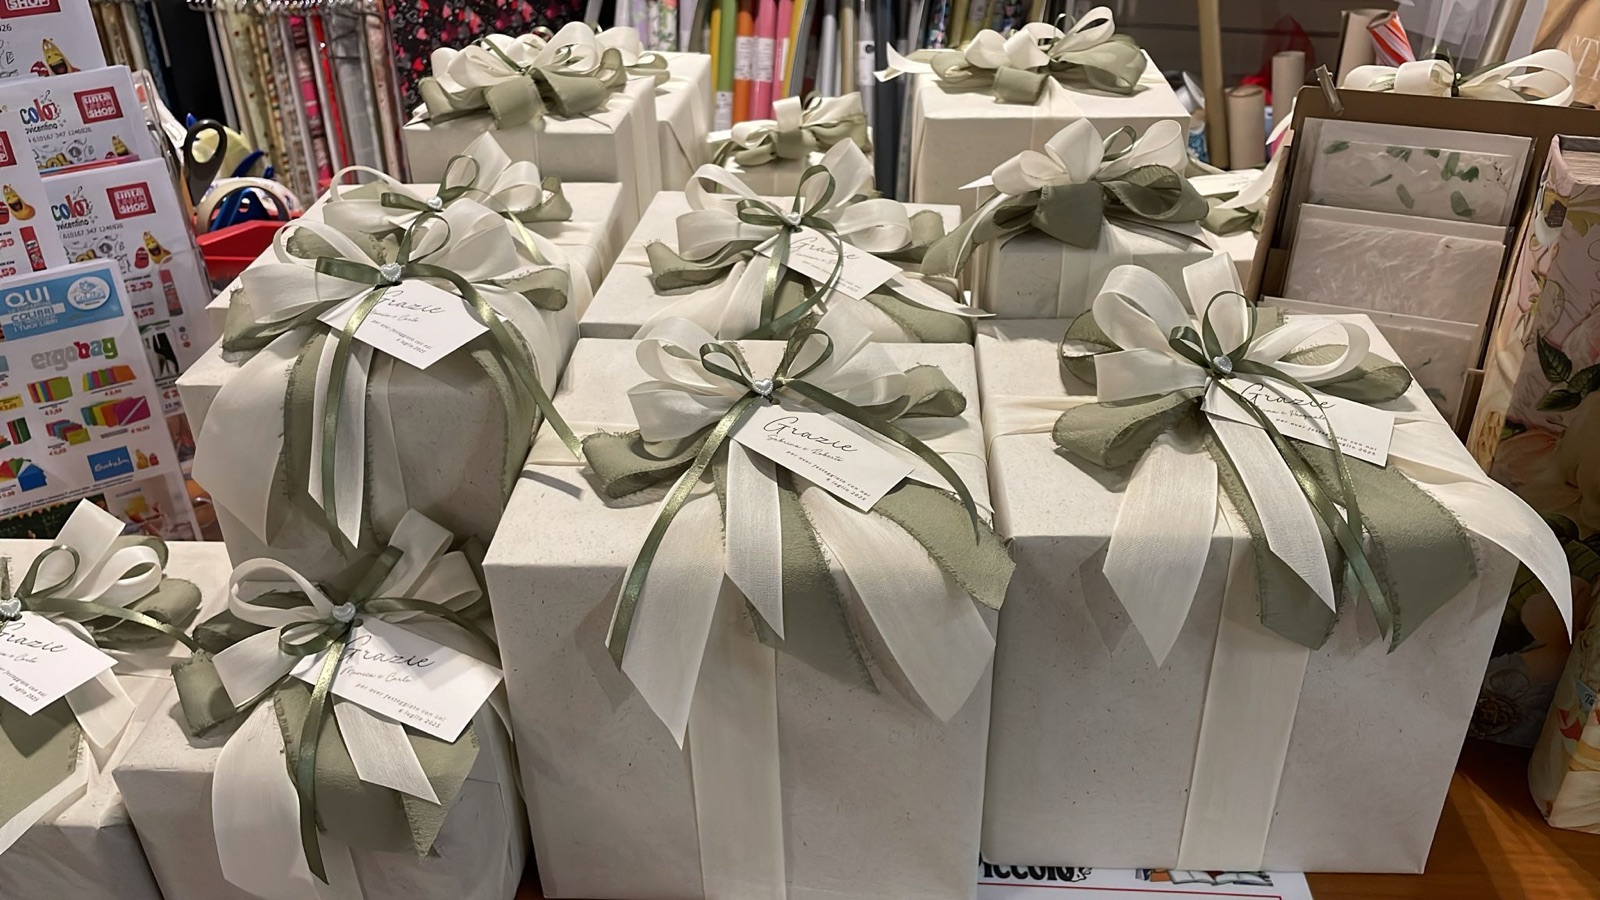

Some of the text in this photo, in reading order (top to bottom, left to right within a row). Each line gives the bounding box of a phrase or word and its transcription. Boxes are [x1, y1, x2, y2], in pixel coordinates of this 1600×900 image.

[5, 286, 50, 308] QUI
[31, 337, 119, 371] ergobag
[1240, 382, 1336, 409] Grazie
[763, 416, 858, 452] Grazie
[767, 434, 801, 449] Sabrina
[847, 482, 859, 491] con
[859, 489, 871, 497] noi
[338, 635, 435, 668] Grazie
